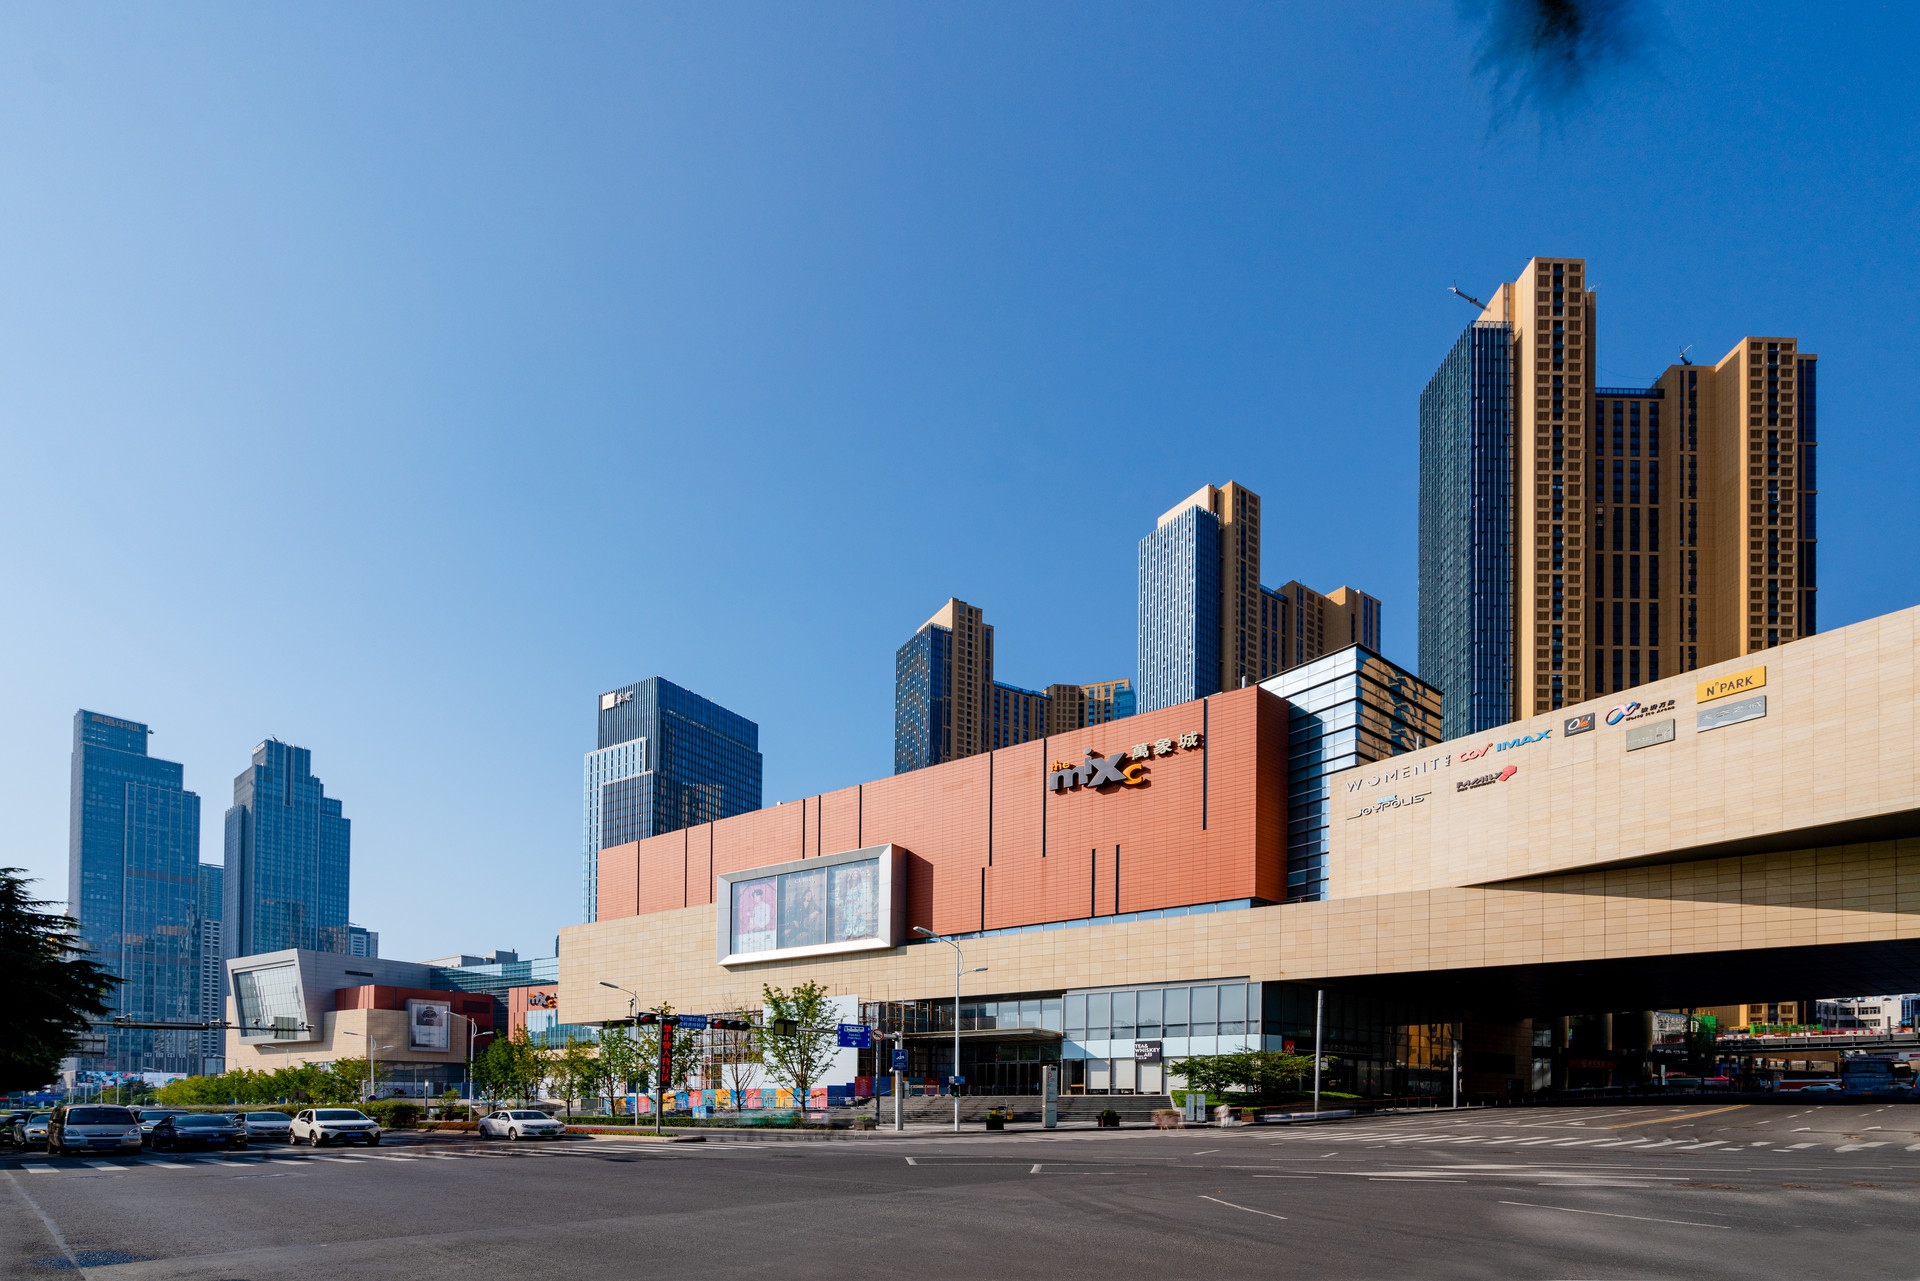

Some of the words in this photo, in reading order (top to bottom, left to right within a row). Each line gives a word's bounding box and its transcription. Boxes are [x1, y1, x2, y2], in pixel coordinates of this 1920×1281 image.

[1132, 731, 1199, 760] 萬象城
[1496, 729, 1552, 752] IMAX
[1458, 743, 1493, 763] CGV
[1051, 760, 1070, 772] the
[661, 1024, 672, 1082] 禁止驶入待行区
